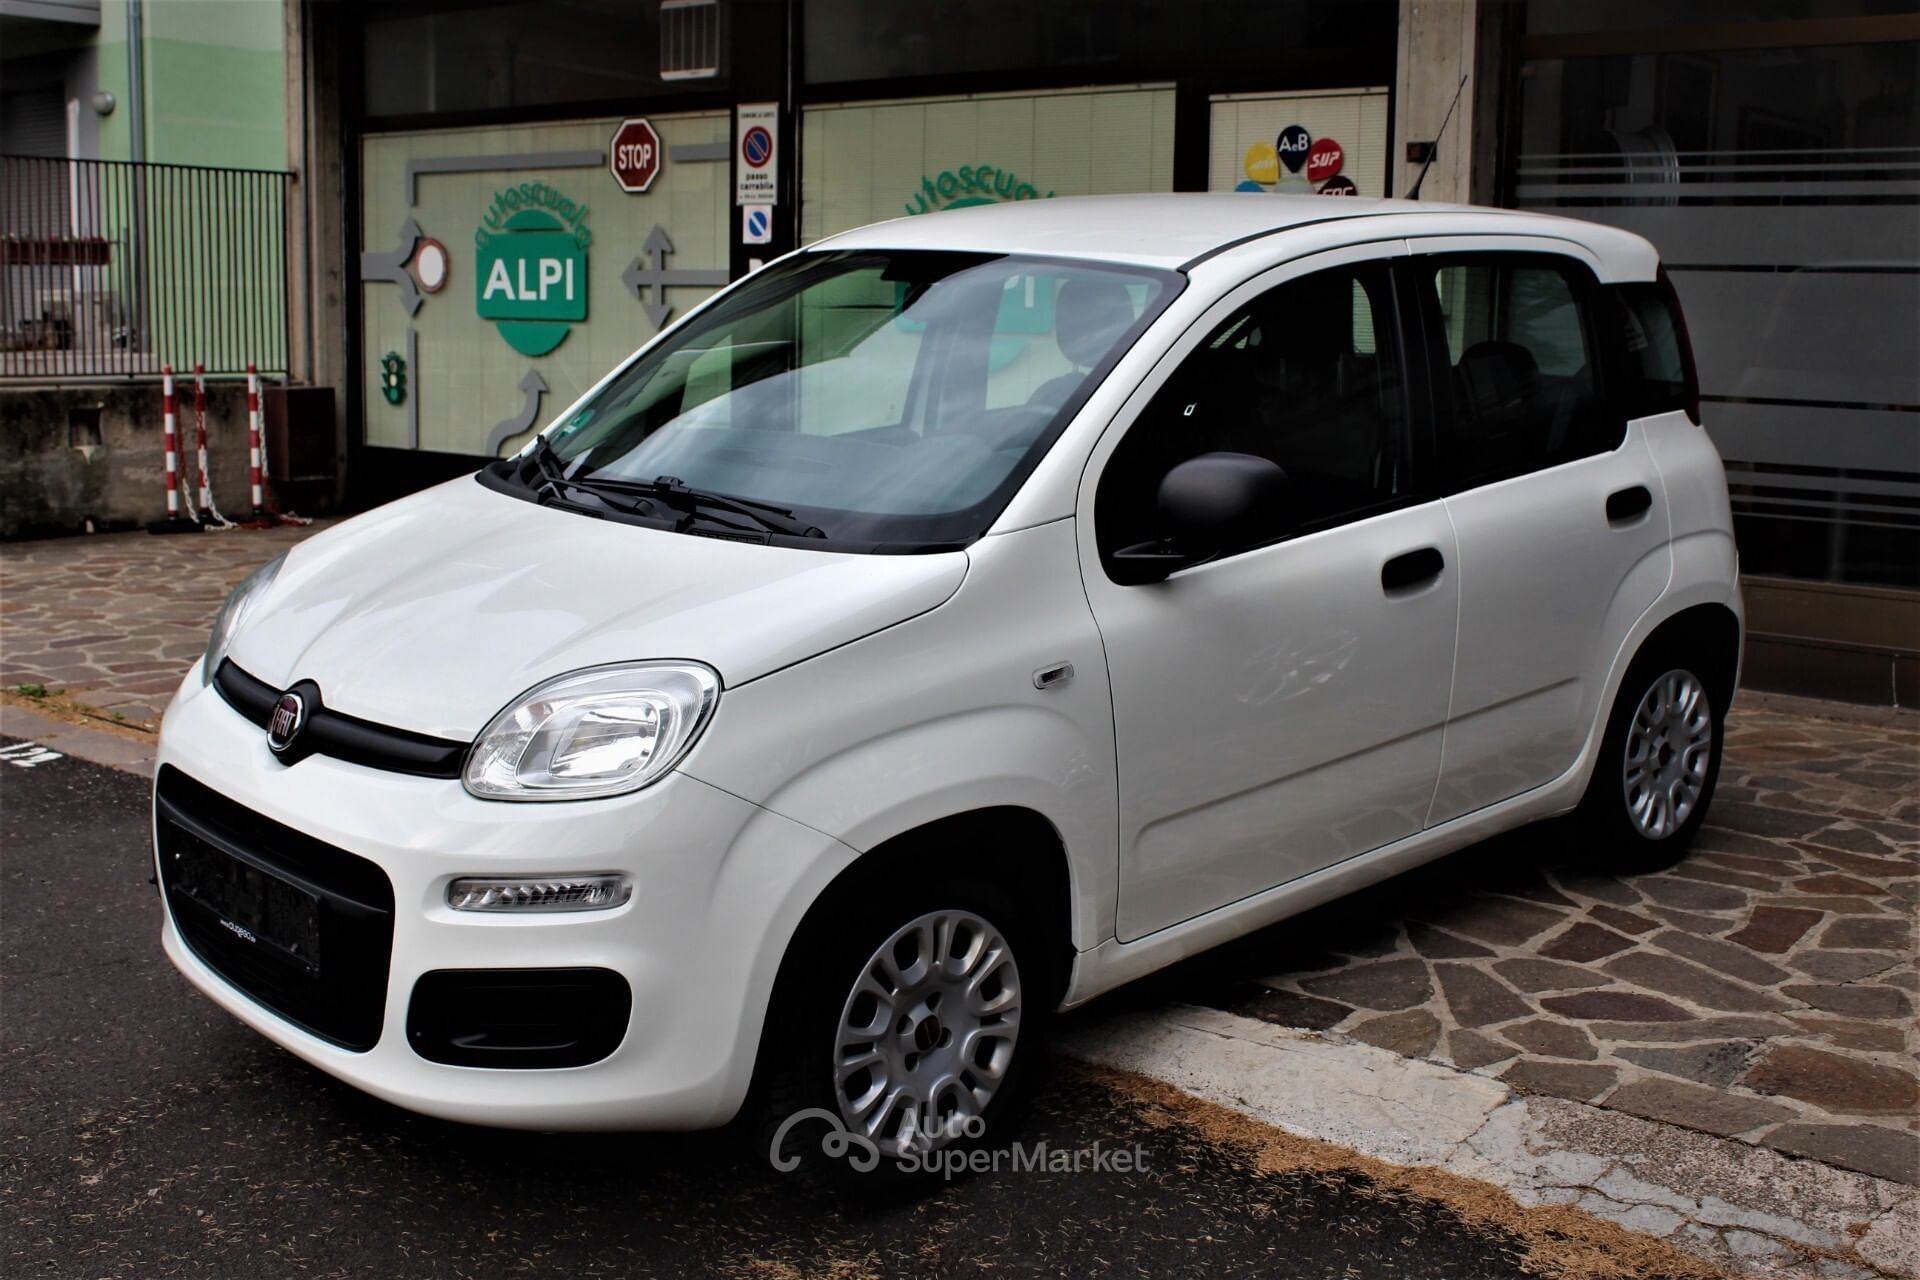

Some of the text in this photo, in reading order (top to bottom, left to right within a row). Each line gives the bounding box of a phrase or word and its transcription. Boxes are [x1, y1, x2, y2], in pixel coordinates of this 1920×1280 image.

[618, 144, 651, 171] STOP
[1309, 152, 1340, 168] SUP
[740, 182, 774, 190] carrabile
[746, 173, 768, 181] passo
[474, 183, 593, 251] autoscuola
[483, 258, 573, 301] ALPI
[273, 707, 297, 737] FIAT
